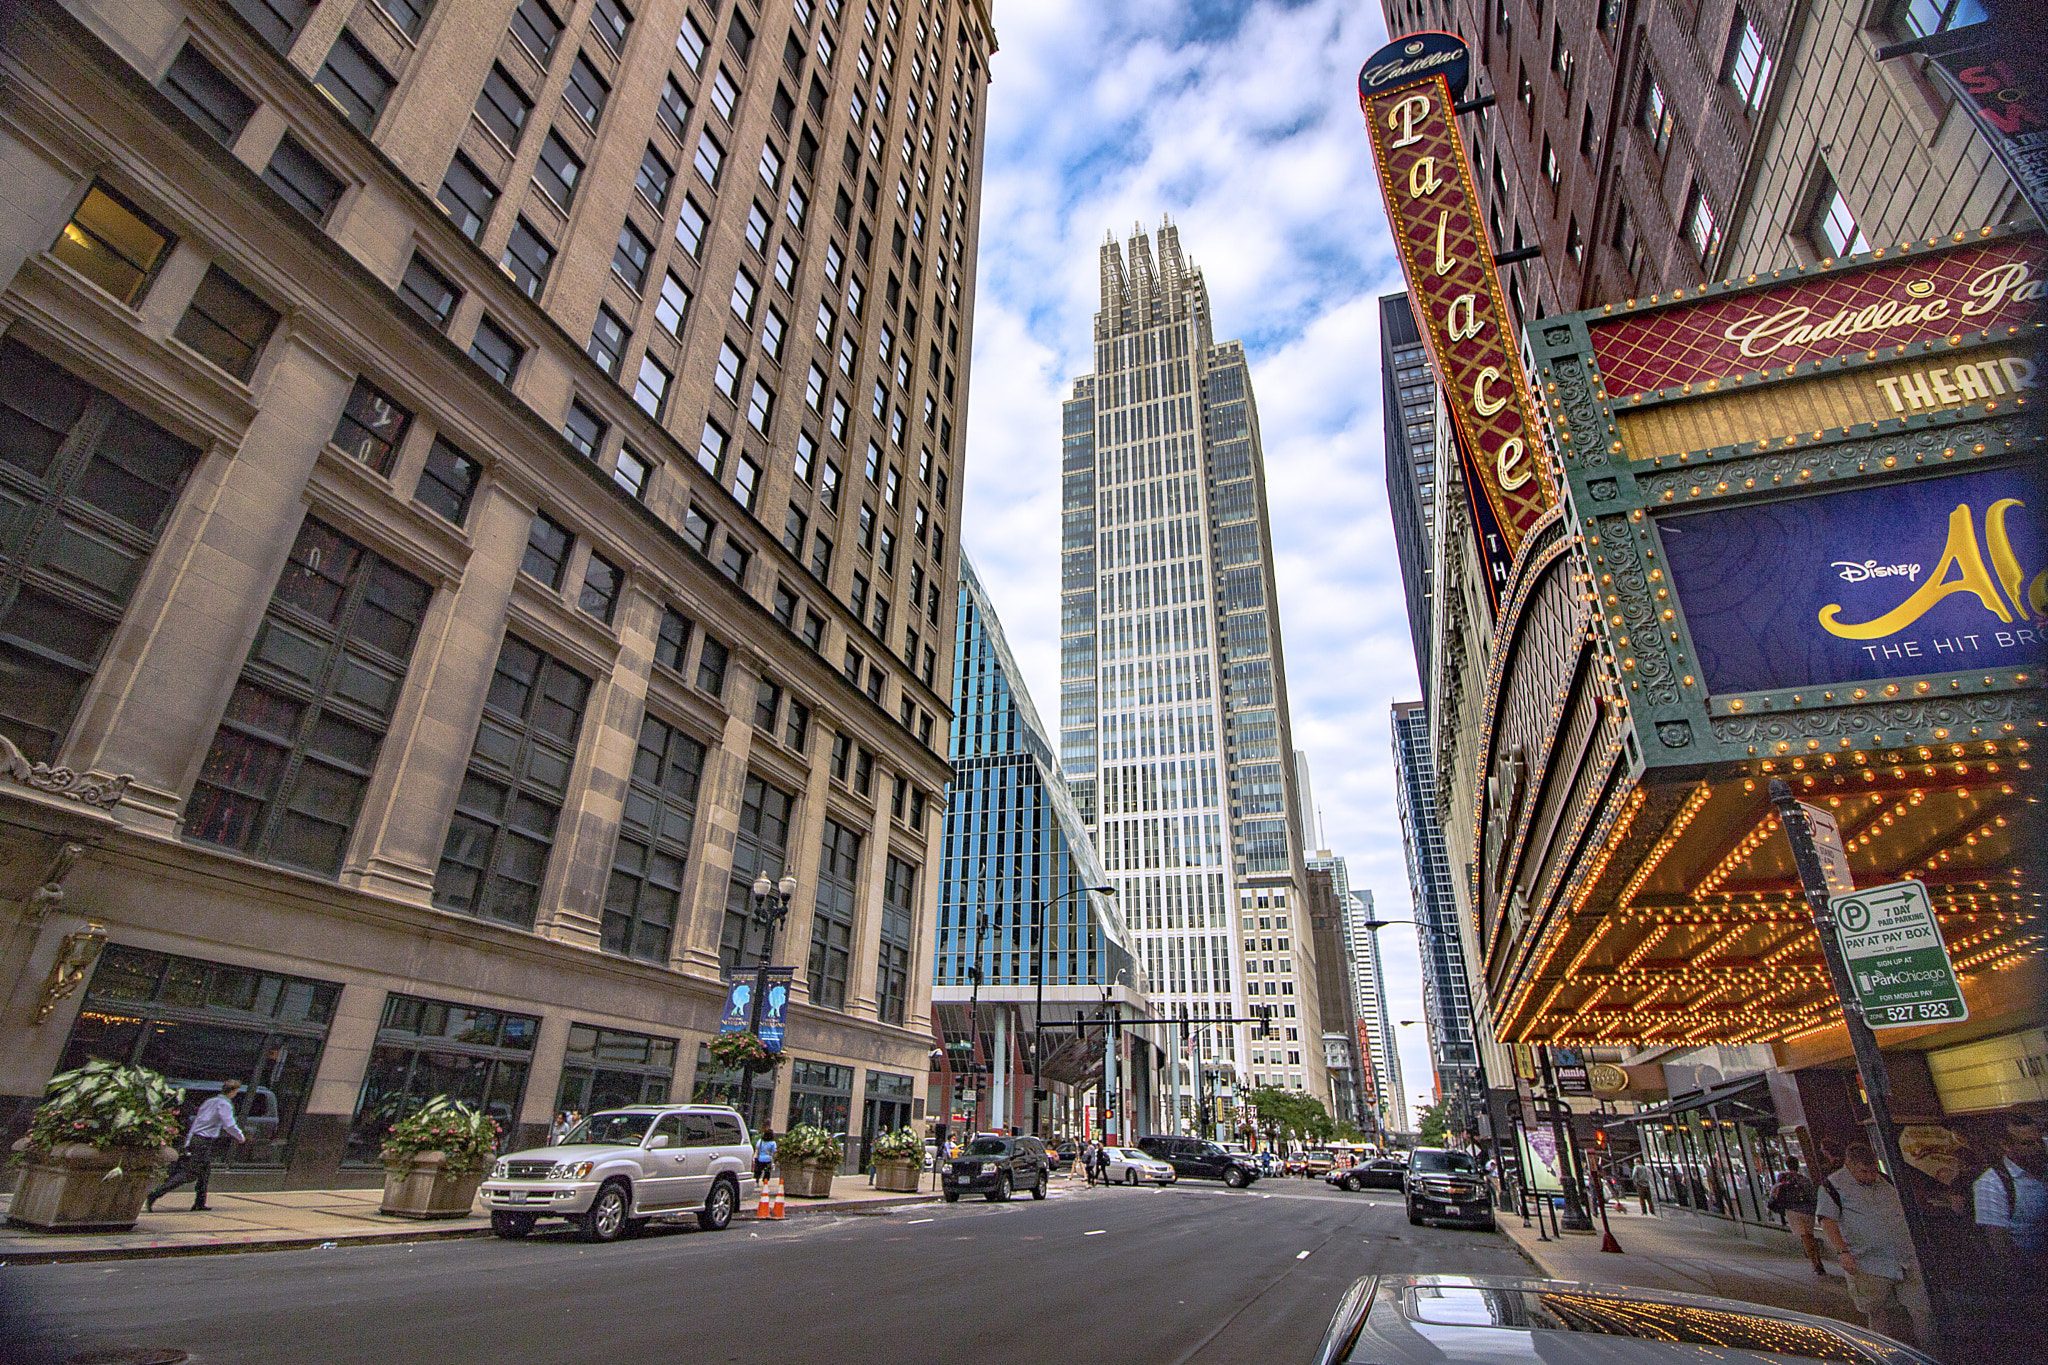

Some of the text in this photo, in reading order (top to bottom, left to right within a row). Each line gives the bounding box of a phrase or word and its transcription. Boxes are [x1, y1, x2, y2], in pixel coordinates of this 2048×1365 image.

[1363, 48, 1463, 86] Cadillac
[1388, 95, 1532, 492] Palace
[1725, 299, 1951, 357] Cadillac
[1862, 641, 1923, 661] THE
[1933, 634, 1979, 654] HIT
[1878, 912, 1925, 927] PAID PARKING
[1884, 904, 1911, 917] 7 DAY
[1846, 926, 1931, 950] PAY AT PAY BOX
[1877, 956, 1913, 968] SIGN UP AT
[1871, 968, 1946, 987] ParkChicago
[1880, 989, 1933, 1002] FOR MOBILE PAY
[1887, 1006, 1914, 1021] 527
[1919, 1003, 1950, 1018] 523
[1360, 1028, 1373, 1092] ORIENTAL
[1558, 1067, 1586, 1078] Annie
